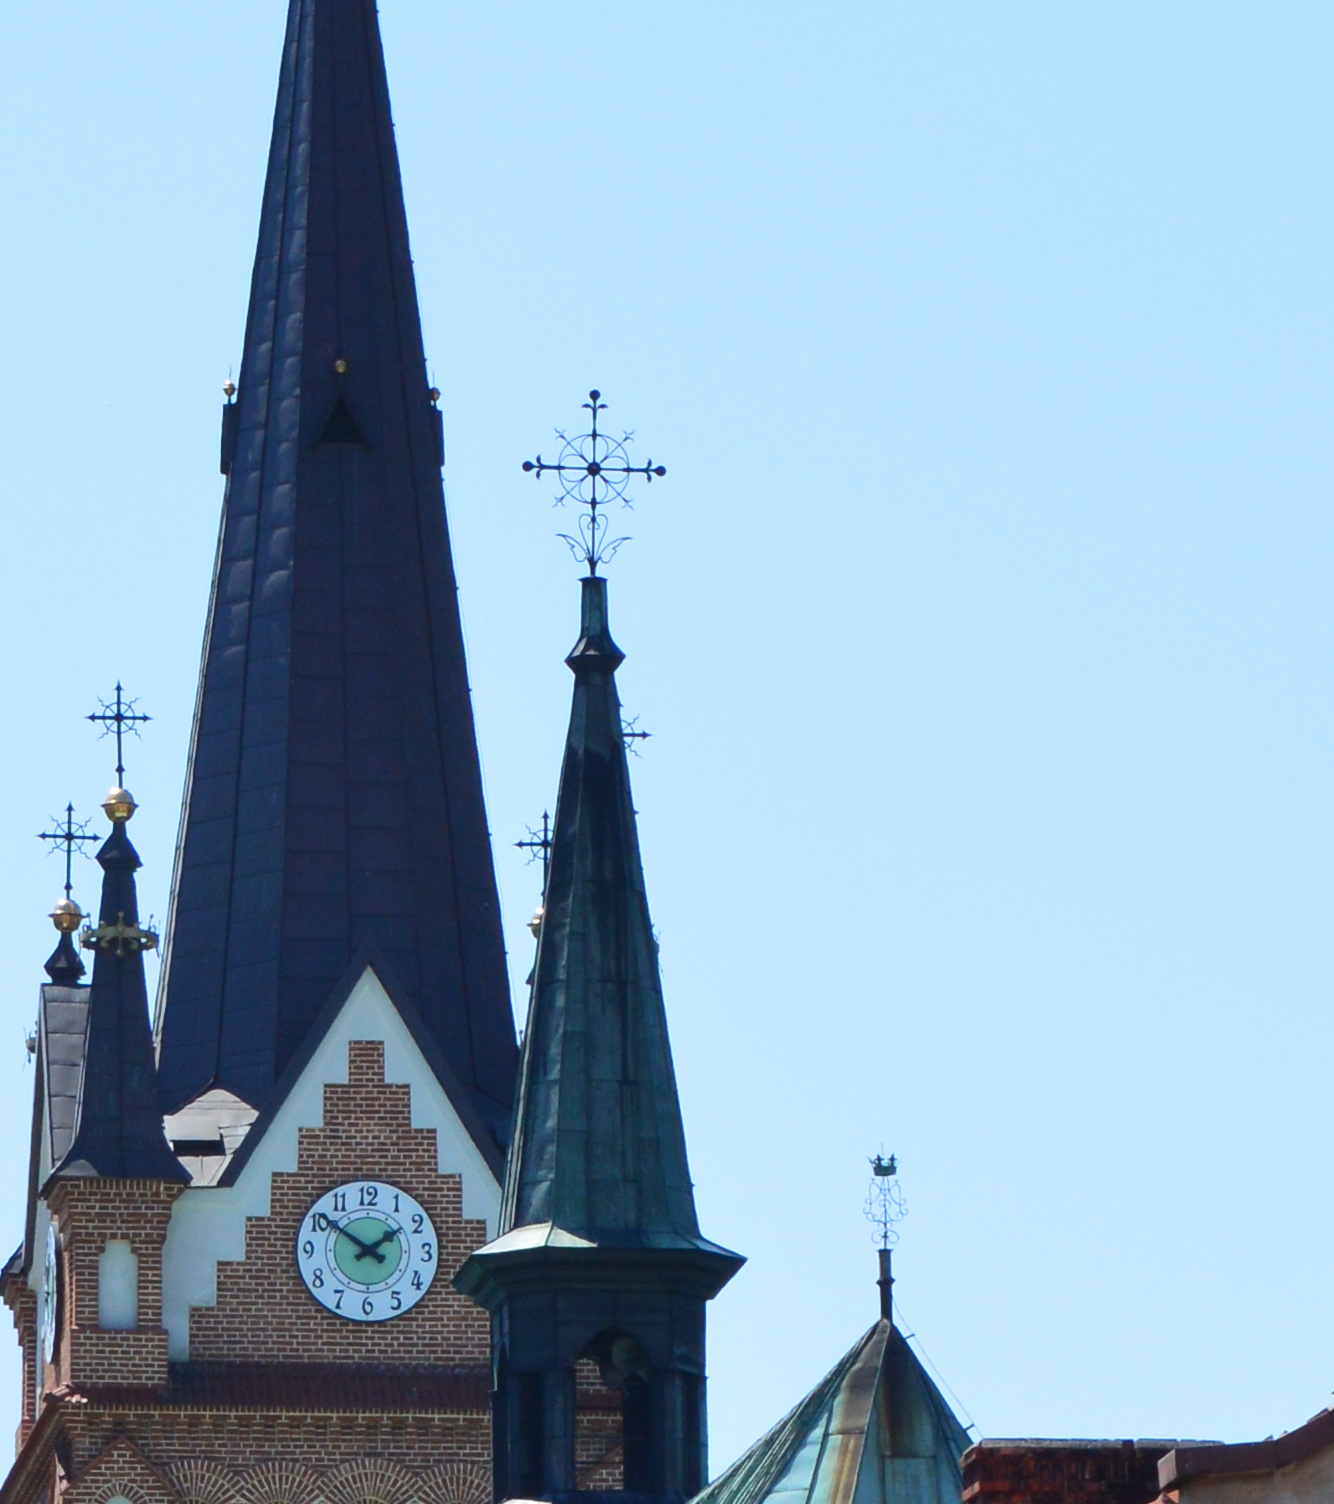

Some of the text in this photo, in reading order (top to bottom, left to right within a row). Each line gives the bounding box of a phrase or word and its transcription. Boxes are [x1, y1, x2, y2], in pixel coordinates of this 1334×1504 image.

[333, 1193, 346, 1211] 11
[358, 1186, 378, 1206] 12
[393, 1194, 400, 1213] 1
[310, 1212, 329, 1232] 10
[412, 1214, 424, 1233] 2
[303, 1240, 314, 1259] 9
[421, 1243, 433, 1262] 3
[312, 1268, 324, 1288] 8
[411, 1271, 424, 1290] 4
[334, 1290, 345, 1310] 7
[362, 1296, 373, 1315] 6
[390, 1291, 401, 1310] 5
